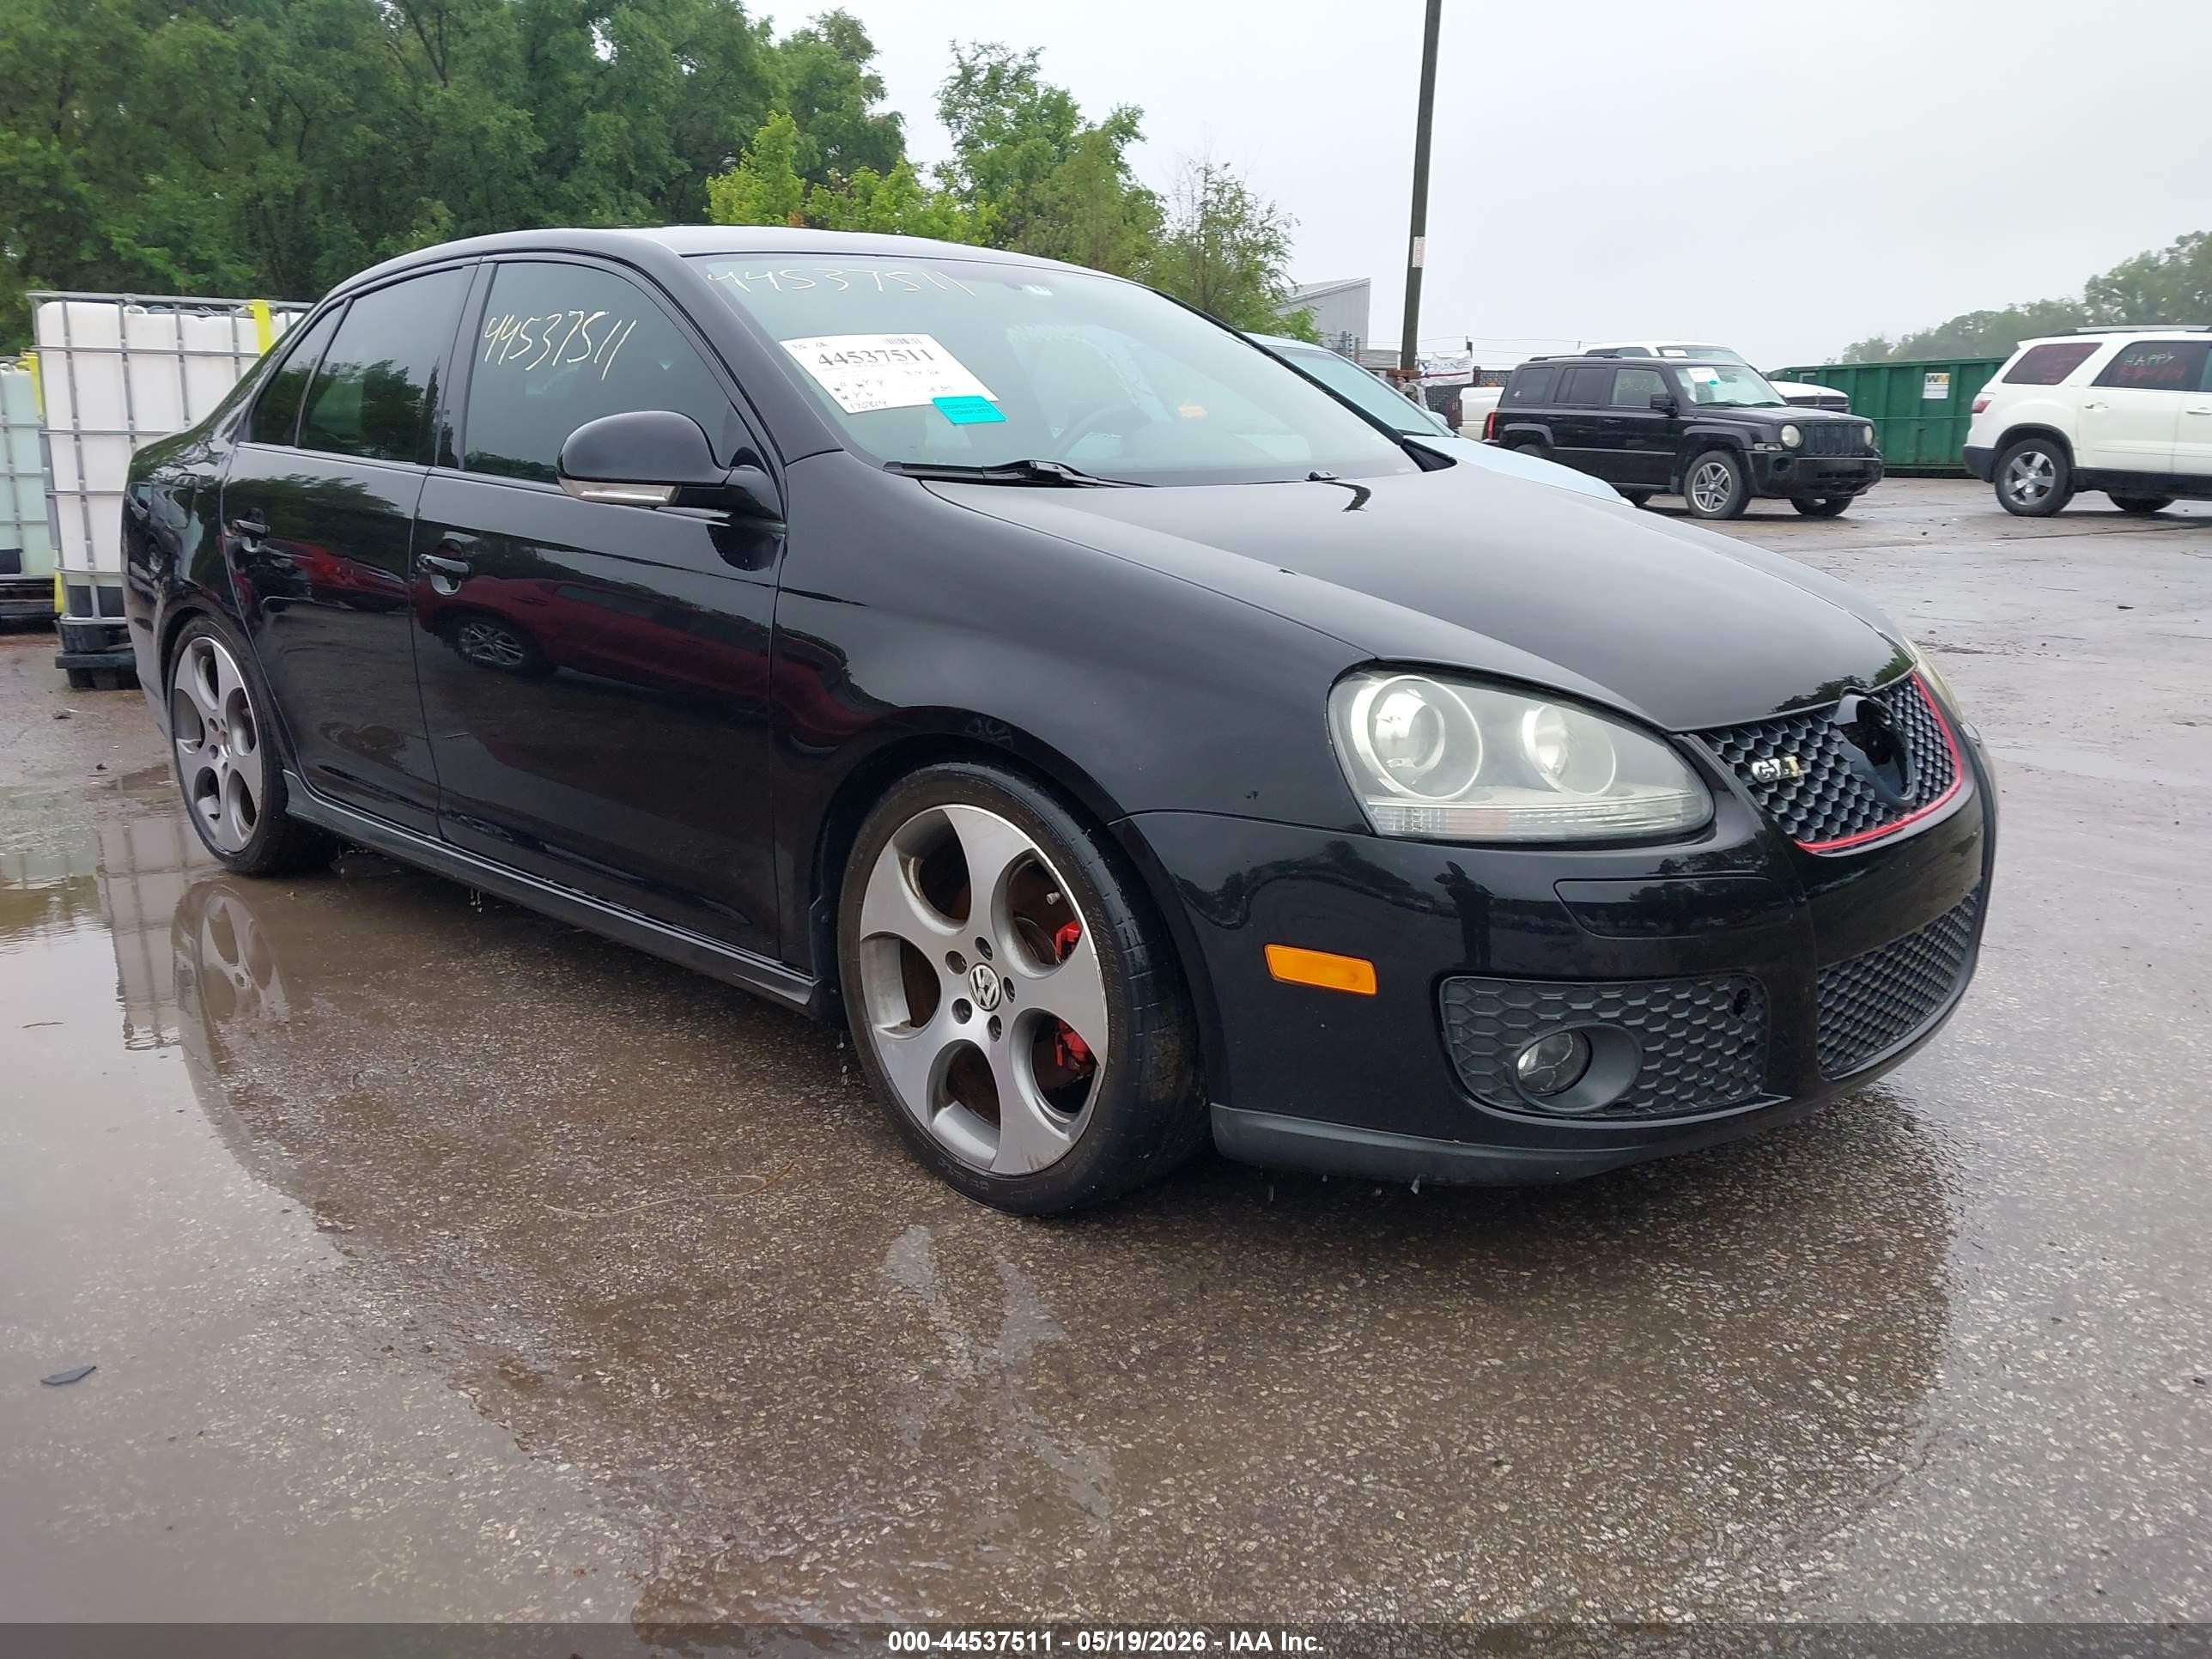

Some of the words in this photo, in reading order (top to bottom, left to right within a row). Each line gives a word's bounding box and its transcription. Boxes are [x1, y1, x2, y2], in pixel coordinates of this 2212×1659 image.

[707, 267, 975, 296] 44537511
[484, 310, 637, 380] 44537511
[818, 349, 935, 366] 44537511
